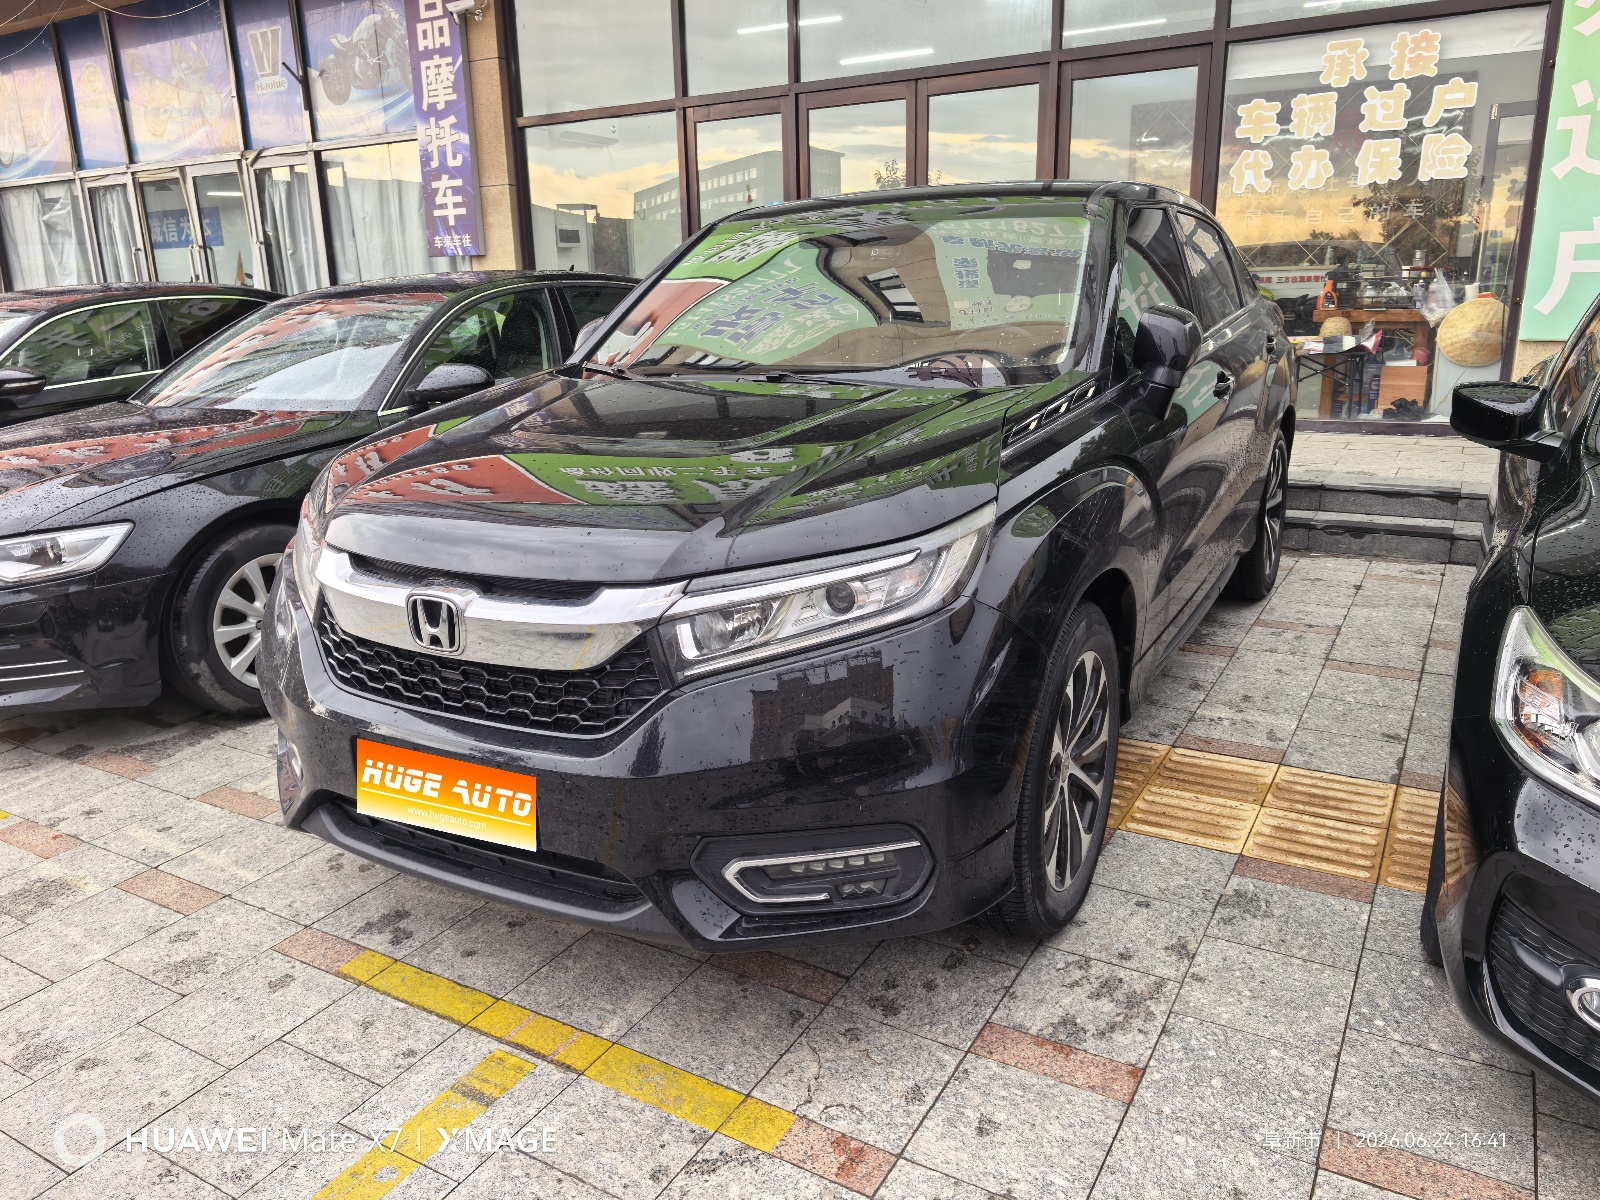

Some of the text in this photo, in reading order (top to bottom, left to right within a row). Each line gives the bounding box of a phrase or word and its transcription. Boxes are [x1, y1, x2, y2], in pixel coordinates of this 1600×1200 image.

[256, 79, 287, 92] Haojue
[1319, 29, 1442, 88] 承接
[416, 0, 467, 227] 品摩托车
[1235, 77, 1479, 144] 车辆过户
[1229, 133, 1473, 194] 代办保险
[433, 232, 472, 249] 车来车往
